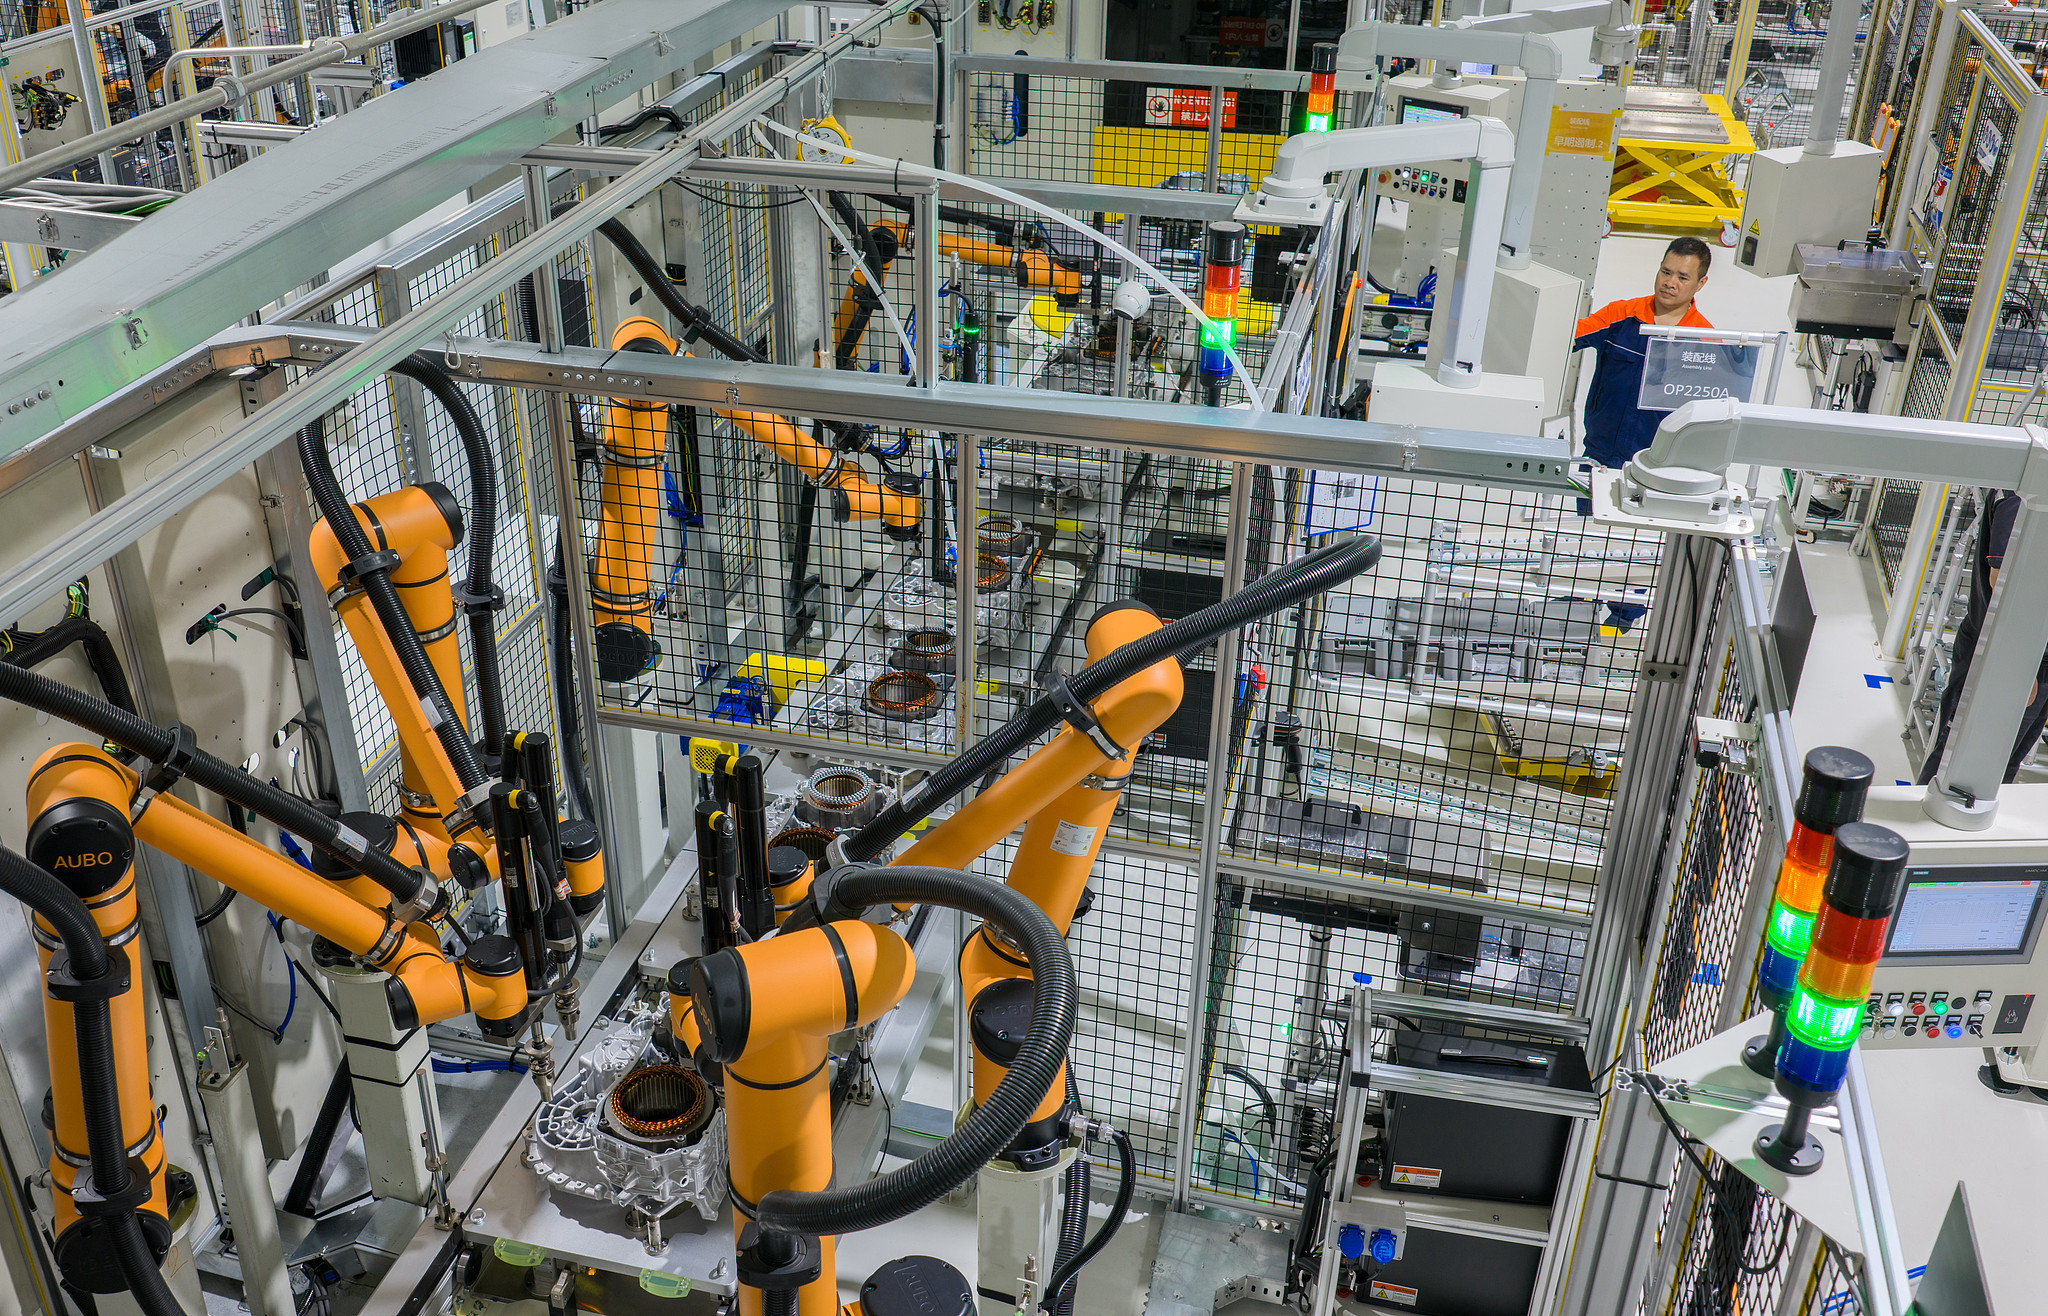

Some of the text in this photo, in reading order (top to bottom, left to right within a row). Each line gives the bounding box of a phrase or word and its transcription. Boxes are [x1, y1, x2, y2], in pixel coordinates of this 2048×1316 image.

[1174, 95, 1235, 107] NO ENTEG!
[1681, 351, 1717, 364] 装配线
[1663, 383, 1729, 399] OP2250A
[53, 851, 113, 870] AUBO
[901, 1271, 936, 1314] AUBO
